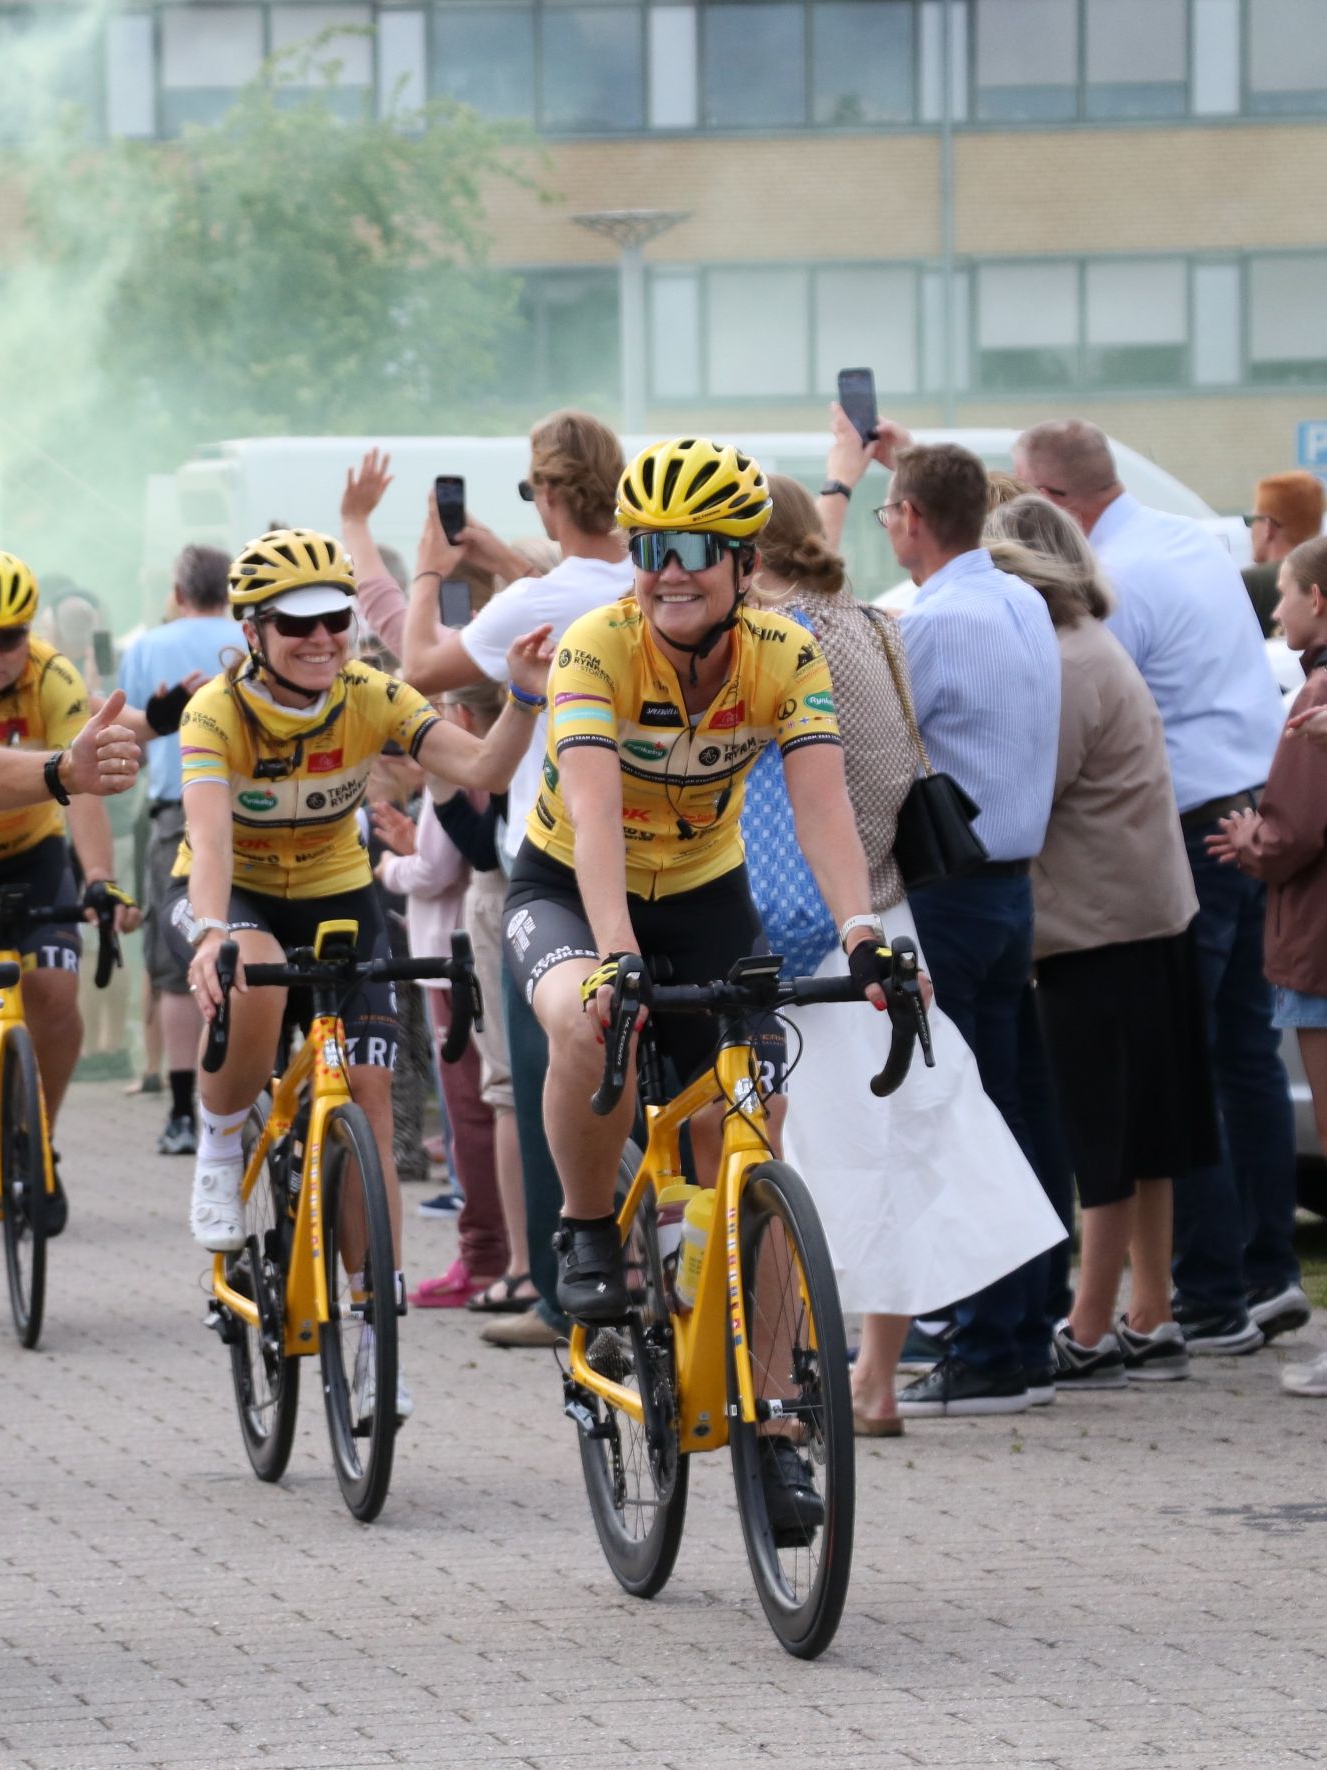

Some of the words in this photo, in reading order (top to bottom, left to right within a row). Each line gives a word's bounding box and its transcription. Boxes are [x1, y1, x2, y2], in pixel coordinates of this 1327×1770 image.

[1306, 422, 1327, 461] P
[575, 648, 601, 666] TEAM
[326, 778, 358, 798] TEAM
[530, 945, 571, 975] TEAM
[617, 1016, 631, 1066] ULTEGRA
